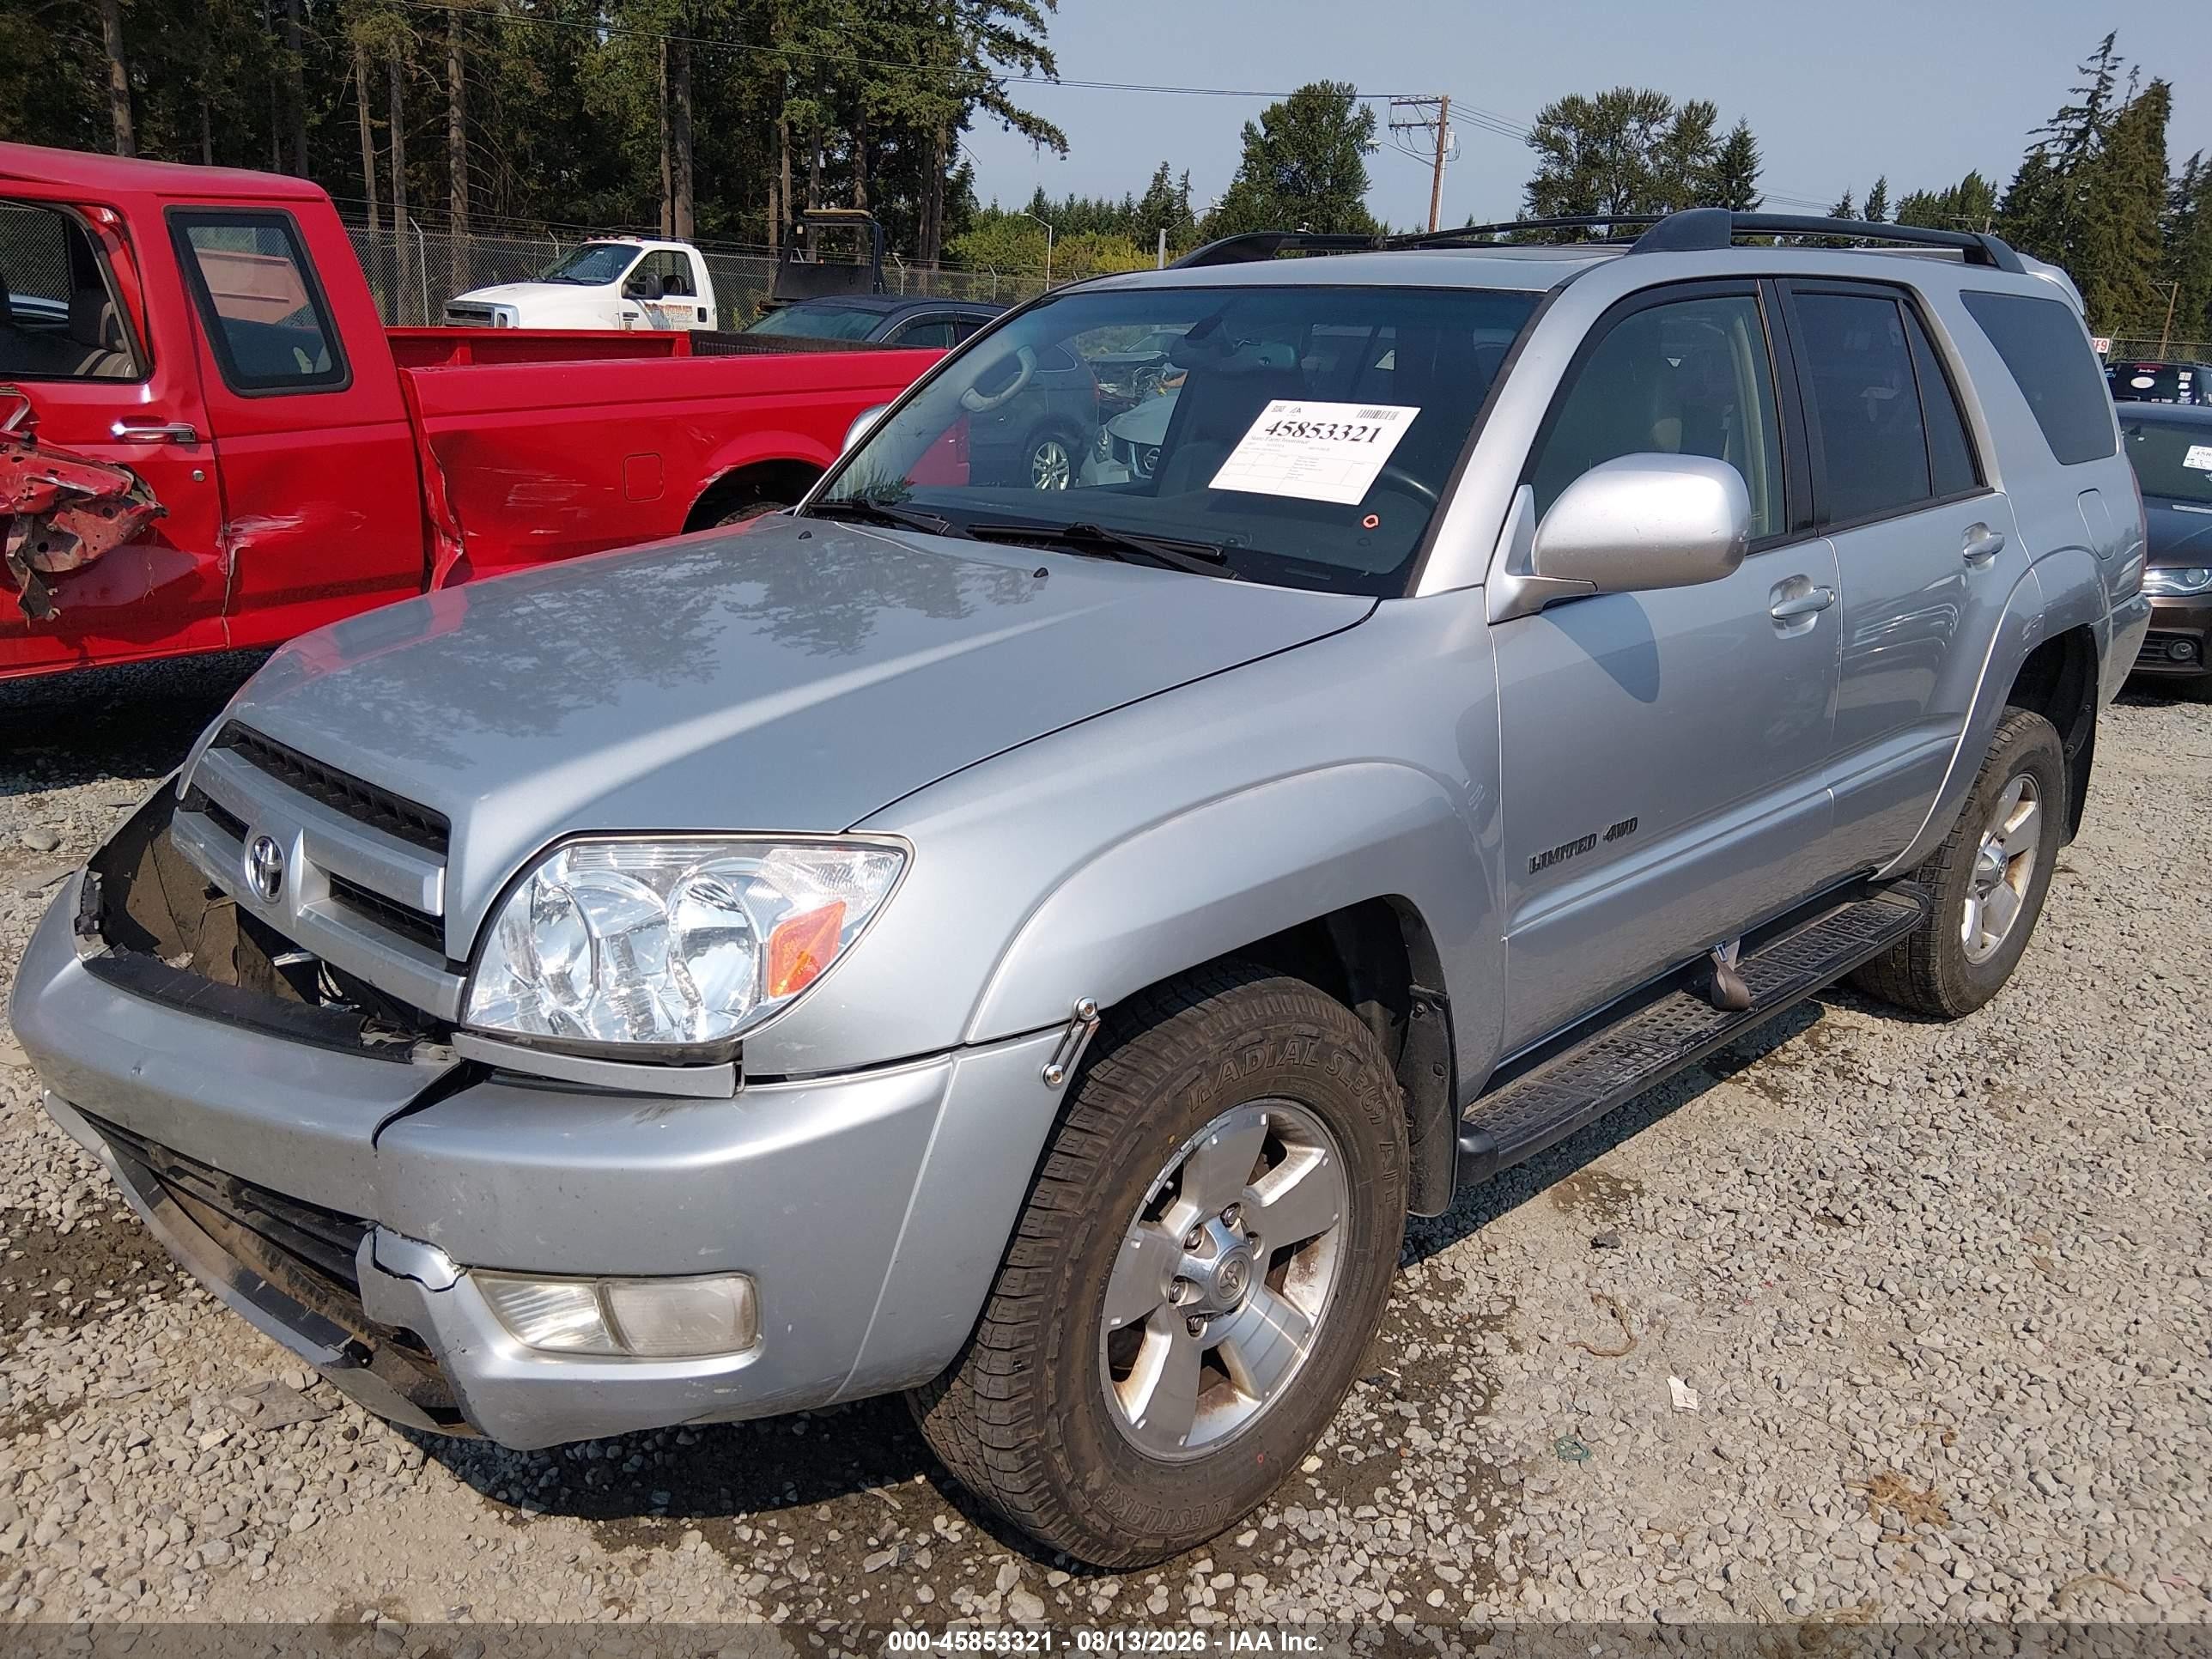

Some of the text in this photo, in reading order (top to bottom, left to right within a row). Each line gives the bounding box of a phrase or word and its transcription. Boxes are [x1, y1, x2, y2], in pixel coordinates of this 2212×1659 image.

[1265, 419, 1383, 444] 45853321
[1528, 817, 1638, 875] LIMITED 4WD
[1188, 1039, 1320, 1114] RADIAL
[1325, 1049, 1387, 1126] SL369
[1095, 1482, 1235, 1534] WESTLAKE
